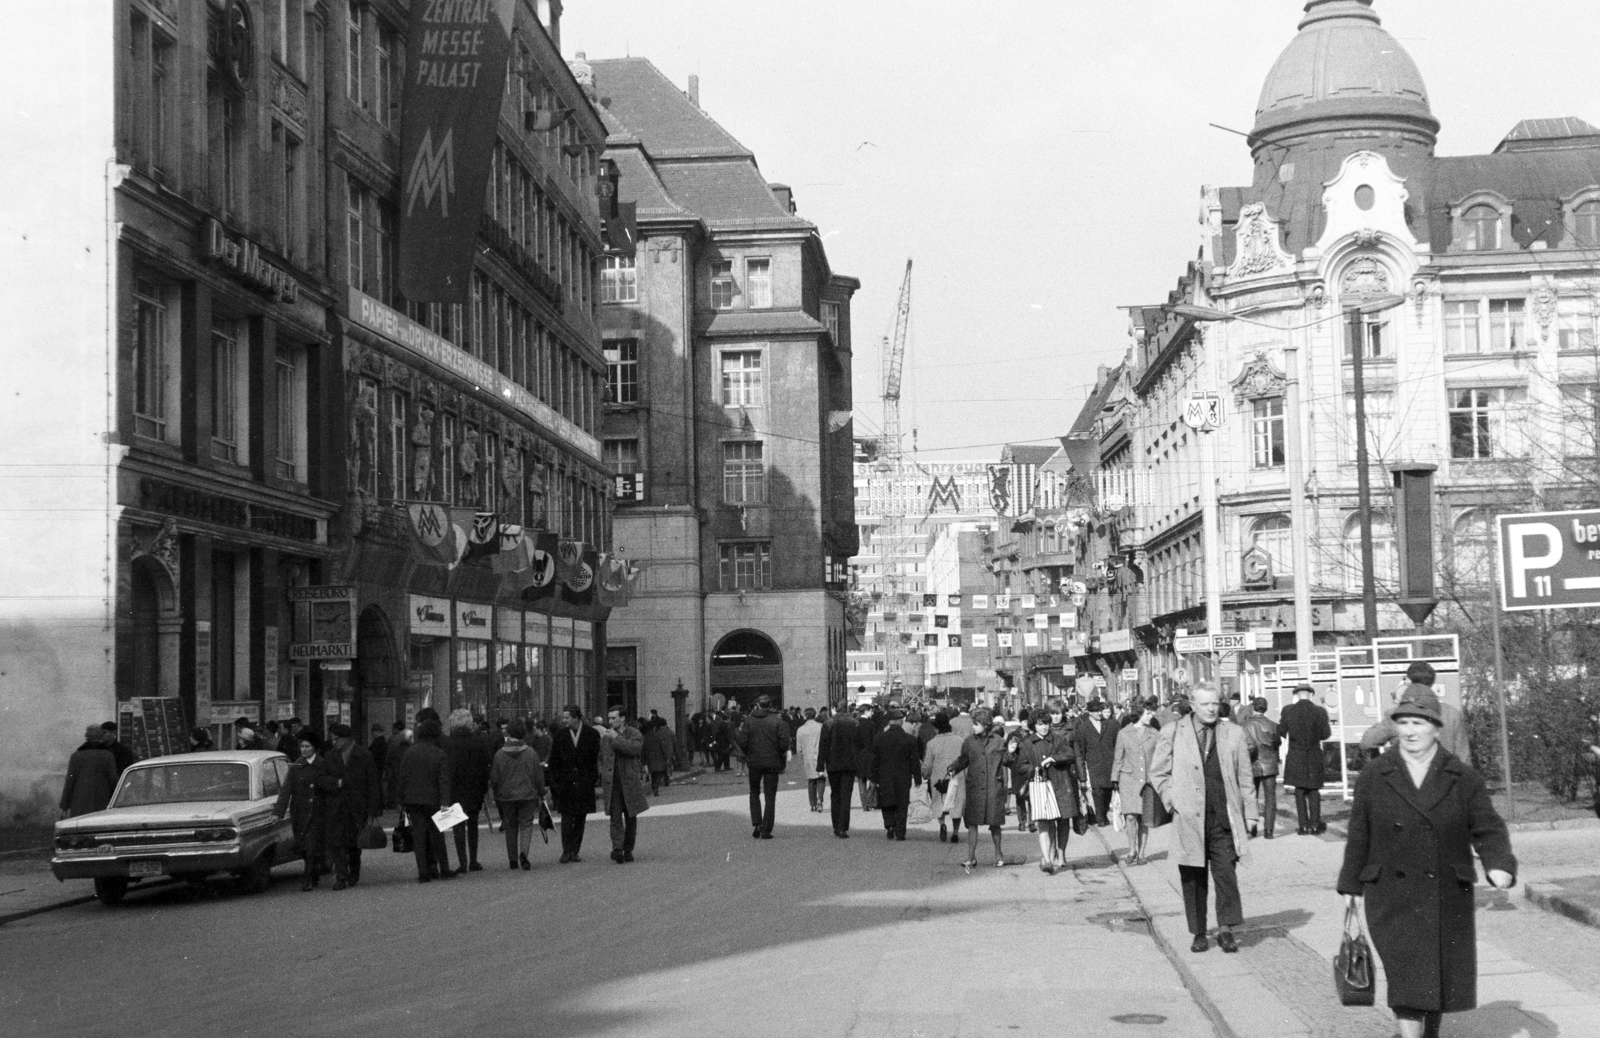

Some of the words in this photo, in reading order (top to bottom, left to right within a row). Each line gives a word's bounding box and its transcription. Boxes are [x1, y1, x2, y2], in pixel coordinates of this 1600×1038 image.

[417, 61, 482, 88] PALAST
[1573, 518, 1600, 543] be
[1508, 522, 1563, 598] P
[1534, 575, 1552, 597] 11
[293, 644, 350, 657] NEUMARKT
[1215, 636, 1244, 648] EBM
